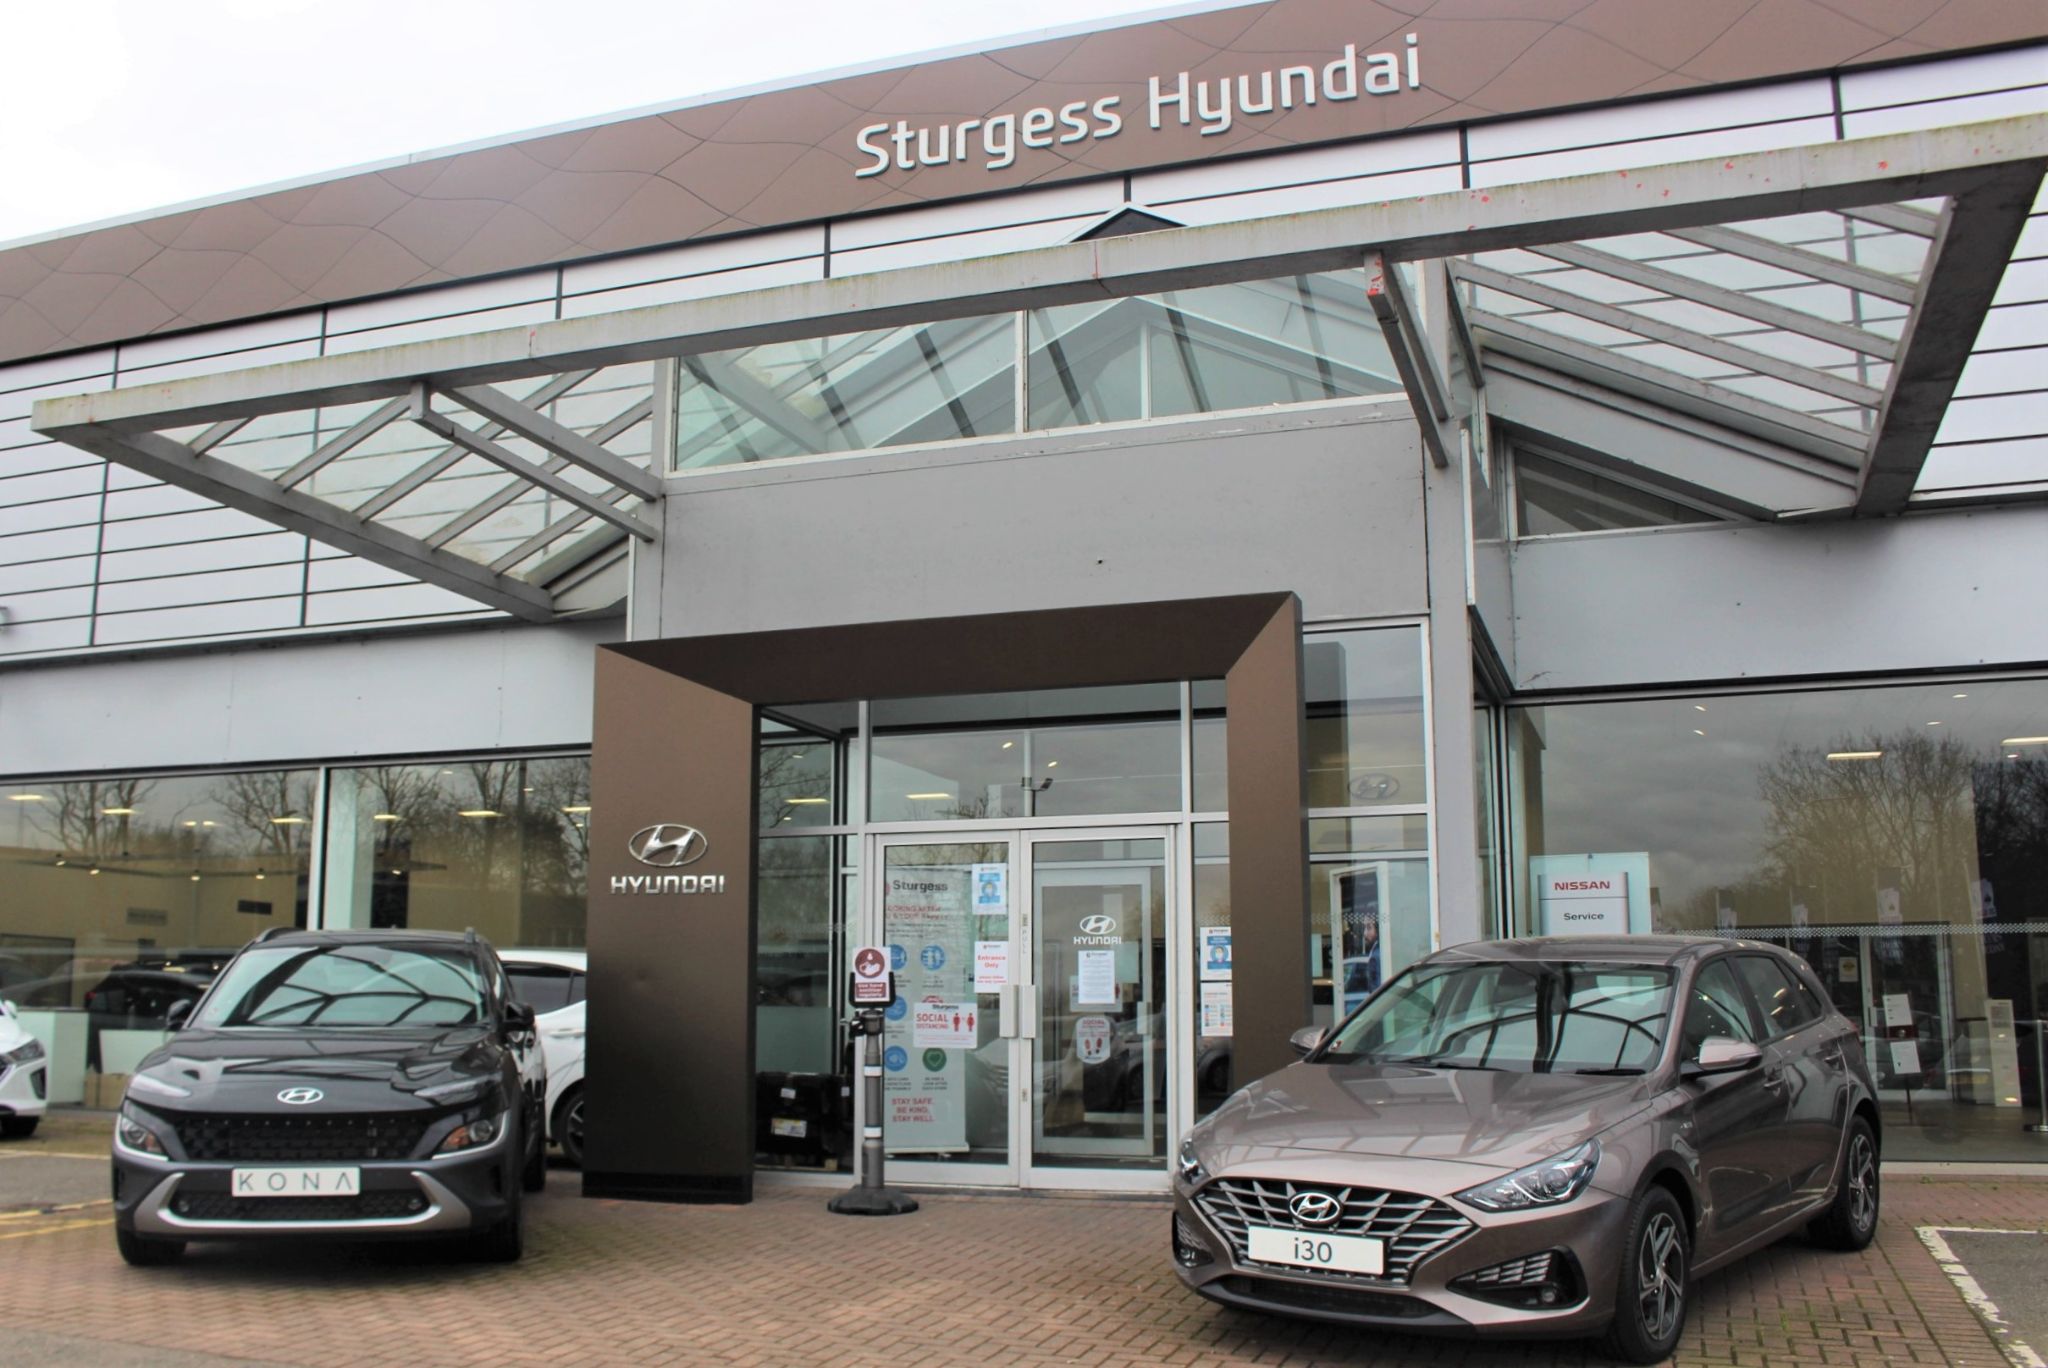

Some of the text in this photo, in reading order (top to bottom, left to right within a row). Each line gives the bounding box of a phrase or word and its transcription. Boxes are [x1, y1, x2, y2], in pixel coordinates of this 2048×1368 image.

[855, 32, 1421, 178] Sturgess Hyundai
[610, 875, 725, 894] HYUNDAI
[893, 879, 948, 893] Sturgess
[1554, 880, 1611, 891] NISSAN
[1563, 912, 1605, 921] Service
[1073, 936, 1122, 945] HYUNDAI
[916, 1013, 948, 1022] SOCIAL
[891, 1097, 911, 1105] STAY
[239, 1171, 353, 1192] KONA
[1293, 1237, 1333, 1263] i30
